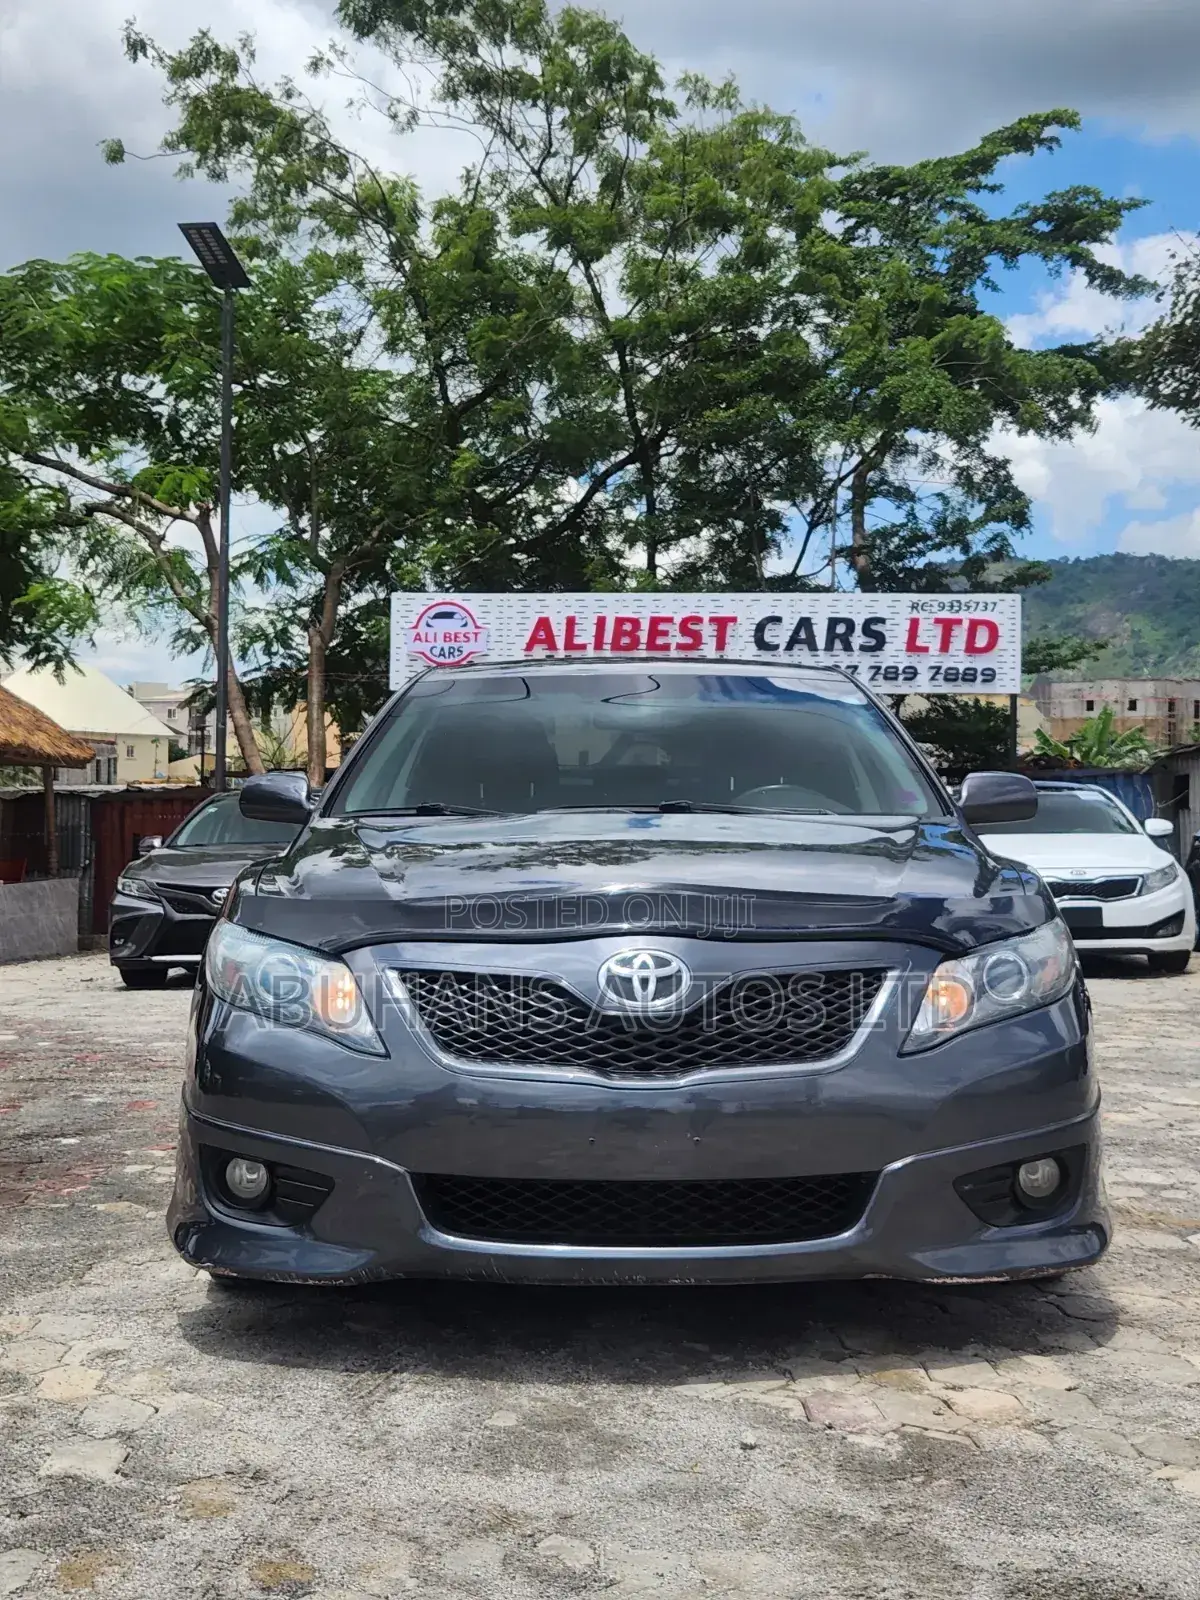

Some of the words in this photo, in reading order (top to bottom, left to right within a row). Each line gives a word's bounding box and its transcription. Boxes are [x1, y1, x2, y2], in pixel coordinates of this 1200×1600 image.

[443, 632, 480, 643] BEST
[524, 615, 737, 651] ALIBEST
[754, 615, 887, 651] CARS
[905, 617, 999, 654] LTD
[430, 646, 464, 659] CARS
[868, 665, 918, 681] 789
[928, 666, 997, 683] 7889
